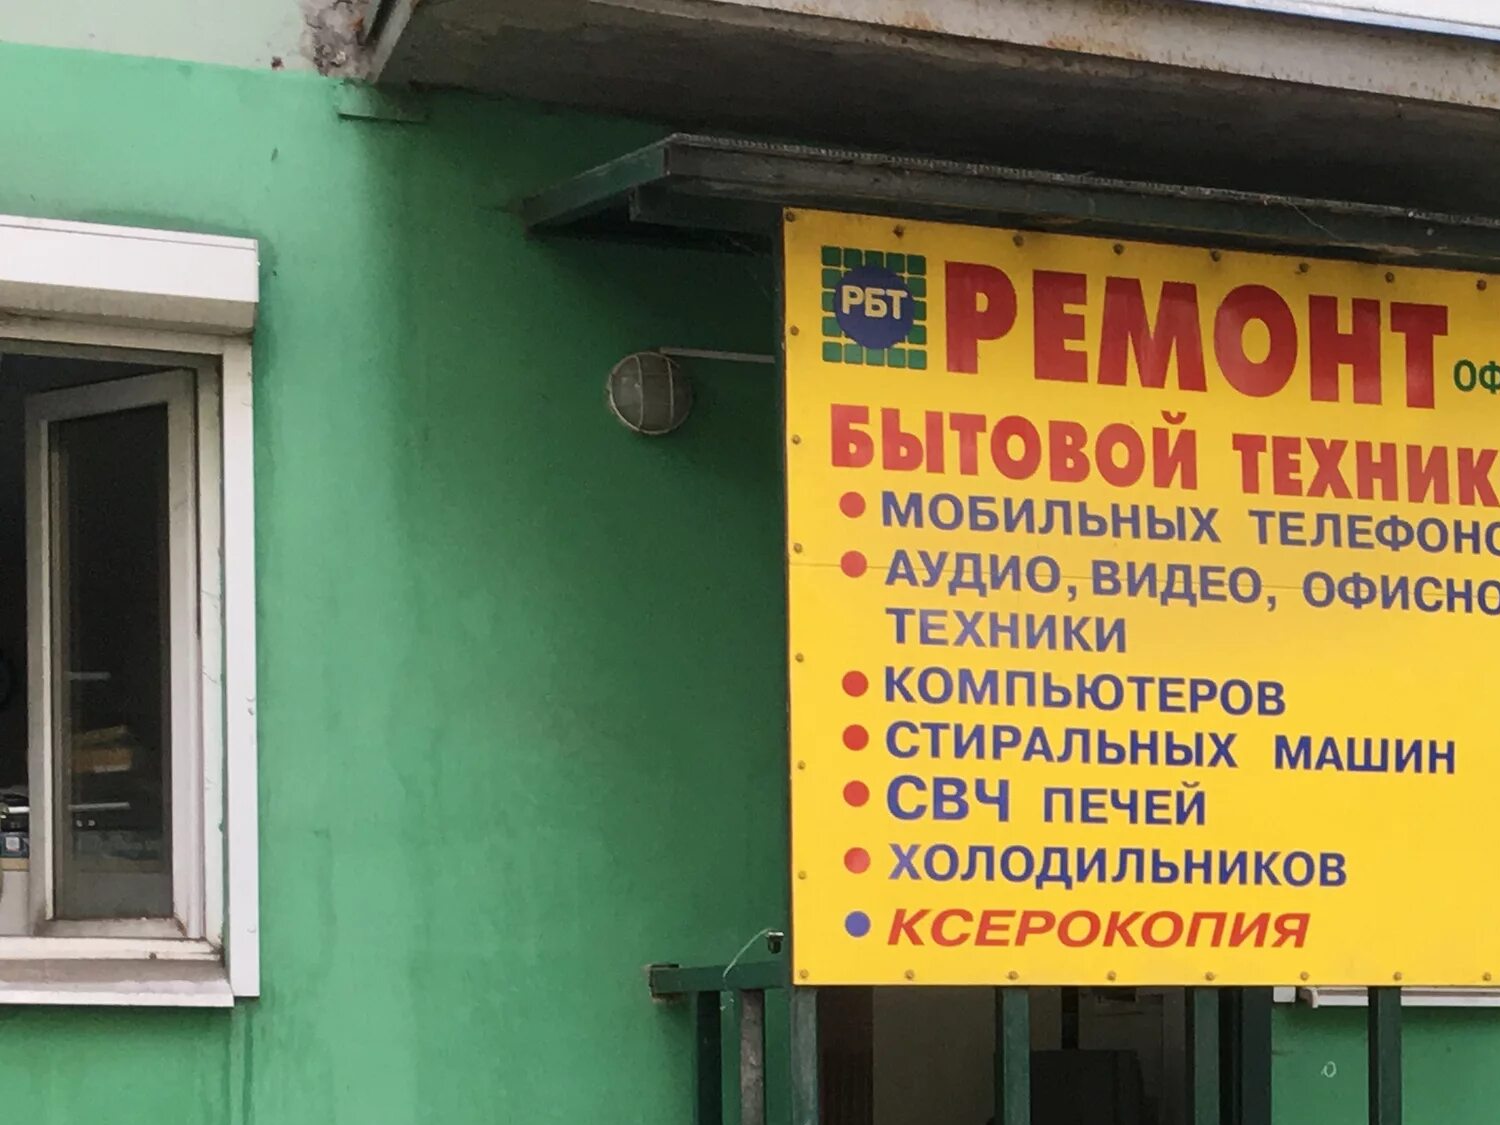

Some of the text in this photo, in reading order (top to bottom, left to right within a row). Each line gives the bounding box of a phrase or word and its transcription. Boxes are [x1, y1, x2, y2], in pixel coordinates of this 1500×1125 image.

[843, 286, 907, 320] РБТ
[946, 263, 1447, 409] РЕМОНТ
[831, 403, 1198, 490] БЫТОВОЙ
[882, 491, 1220, 543] МОБИЛЬНЫХ
[886, 550, 1077, 602] АУДИО,
[1092, 560, 1276, 612] ВИДЕО,
[886, 608, 1126, 653] ТЕХНИКИ
[885, 667, 1286, 715] КОМПЬЮТЕРОВ
[886, 721, 1455, 775] СТИРАЛЬНЫХ МАШИН
[886, 775, 1205, 826] СВЧ ПЕЧЕЙ
[889, 844, 1347, 890] ХОЛОДИЛЬНИКОВ
[887, 908, 1311, 949] КСЕРОКОПИЯ
